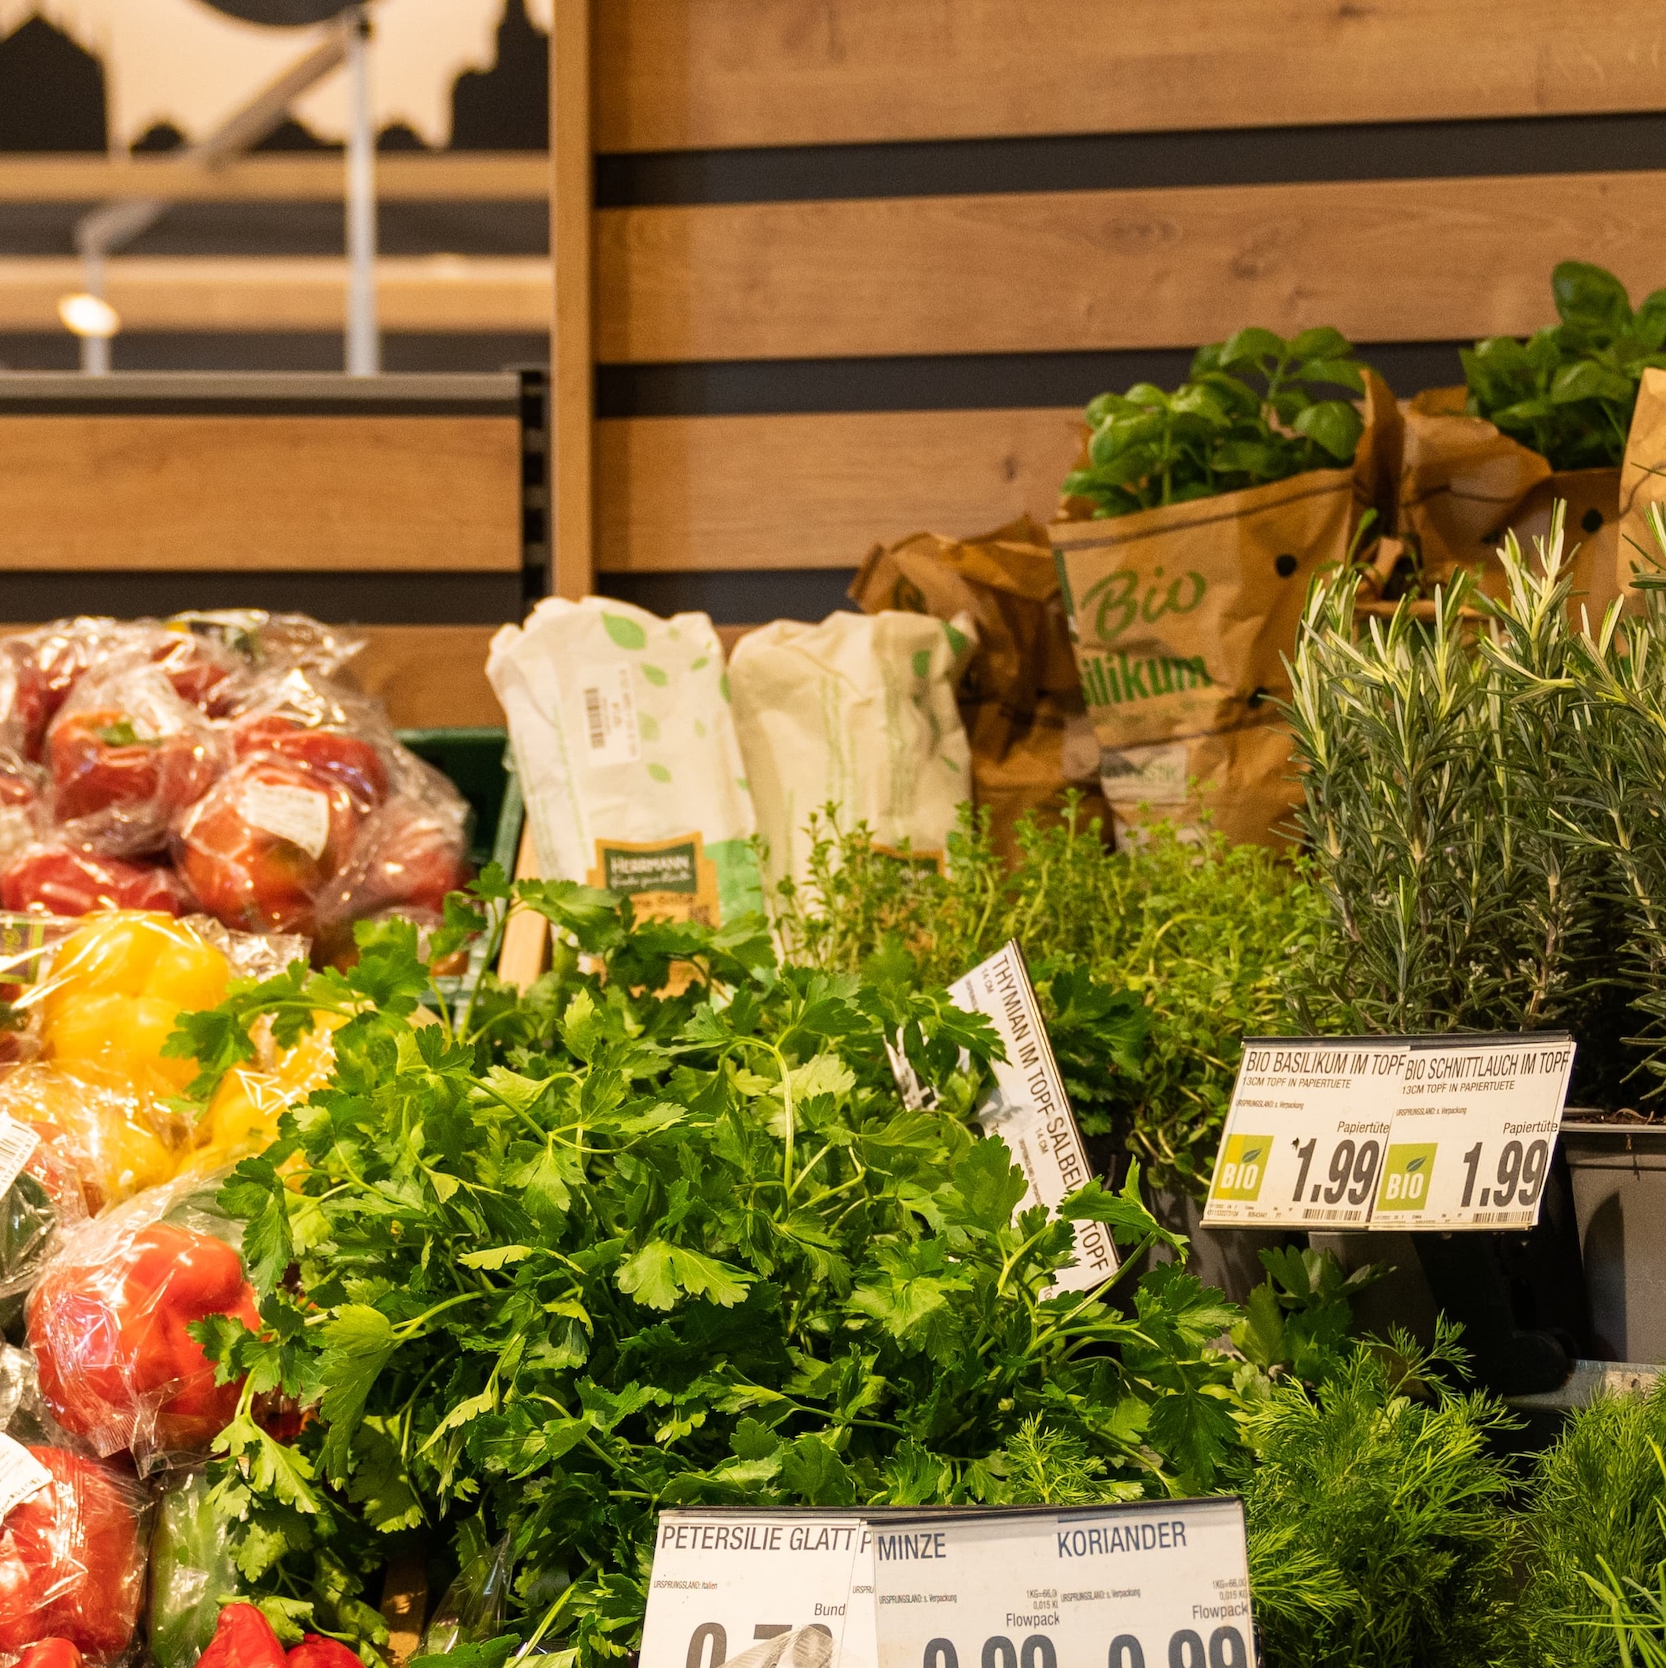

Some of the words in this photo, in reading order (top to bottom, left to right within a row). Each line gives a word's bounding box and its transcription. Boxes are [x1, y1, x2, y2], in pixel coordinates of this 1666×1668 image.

[1081, 566, 1206, 641] Bio
[992, 955, 1028, 1042] THYMIAN
[1018, 1040, 1041, 1068] IM
[1246, 1052, 1267, 1072] BIO
[1273, 1052, 1348, 1075] BASILIKUM
[1350, 1054, 1370, 1075] IM
[1373, 1054, 1406, 1076] TOPF
[1406, 1060, 1425, 1081] BIO
[1428, 1053, 1517, 1079] SCHNITTLAUCH
[1520, 1053, 1536, 1074] IM
[1538, 1051, 1570, 1074] TOPF
[1027, 1066, 1055, 1118] TOPF
[1242, 1077, 1264, 1087] 13CM
[1267, 1077, 1285, 1088] TOPF
[1288, 1077, 1297, 1088] IN
[1299, 1078, 1351, 1089] PAPIERTUETE
[1402, 1084, 1425, 1095] 13CM
[1427, 1084, 1446, 1094] TOPF
[1449, 1082, 1458, 1093] IN
[1459, 1080, 1514, 1093] PAPIERTUETE
[1337, 1120, 1390, 1136] Papiertüte
[1503, 1120, 1558, 1135] Papiertüte
[1220, 1164, 1258, 1189] BIO
[1292, 1138, 1379, 1206] 1.99
[1461, 1139, 1548, 1207] 1.99
[1386, 1174, 1424, 1200] BIO
[1079, 1220, 1111, 1272] TOPF
[661, 1526, 782, 1550] PETERSILIE
[790, 1527, 856, 1550] GLATT
[878, 1533, 946, 1561] MINZE
[1058, 1521, 1187, 1558] KORIANDER
[814, 1603, 846, 1616] Bund
[1007, 1612, 1059, 1628] Flowpack
[1192, 1604, 1247, 1620] Flowpack
